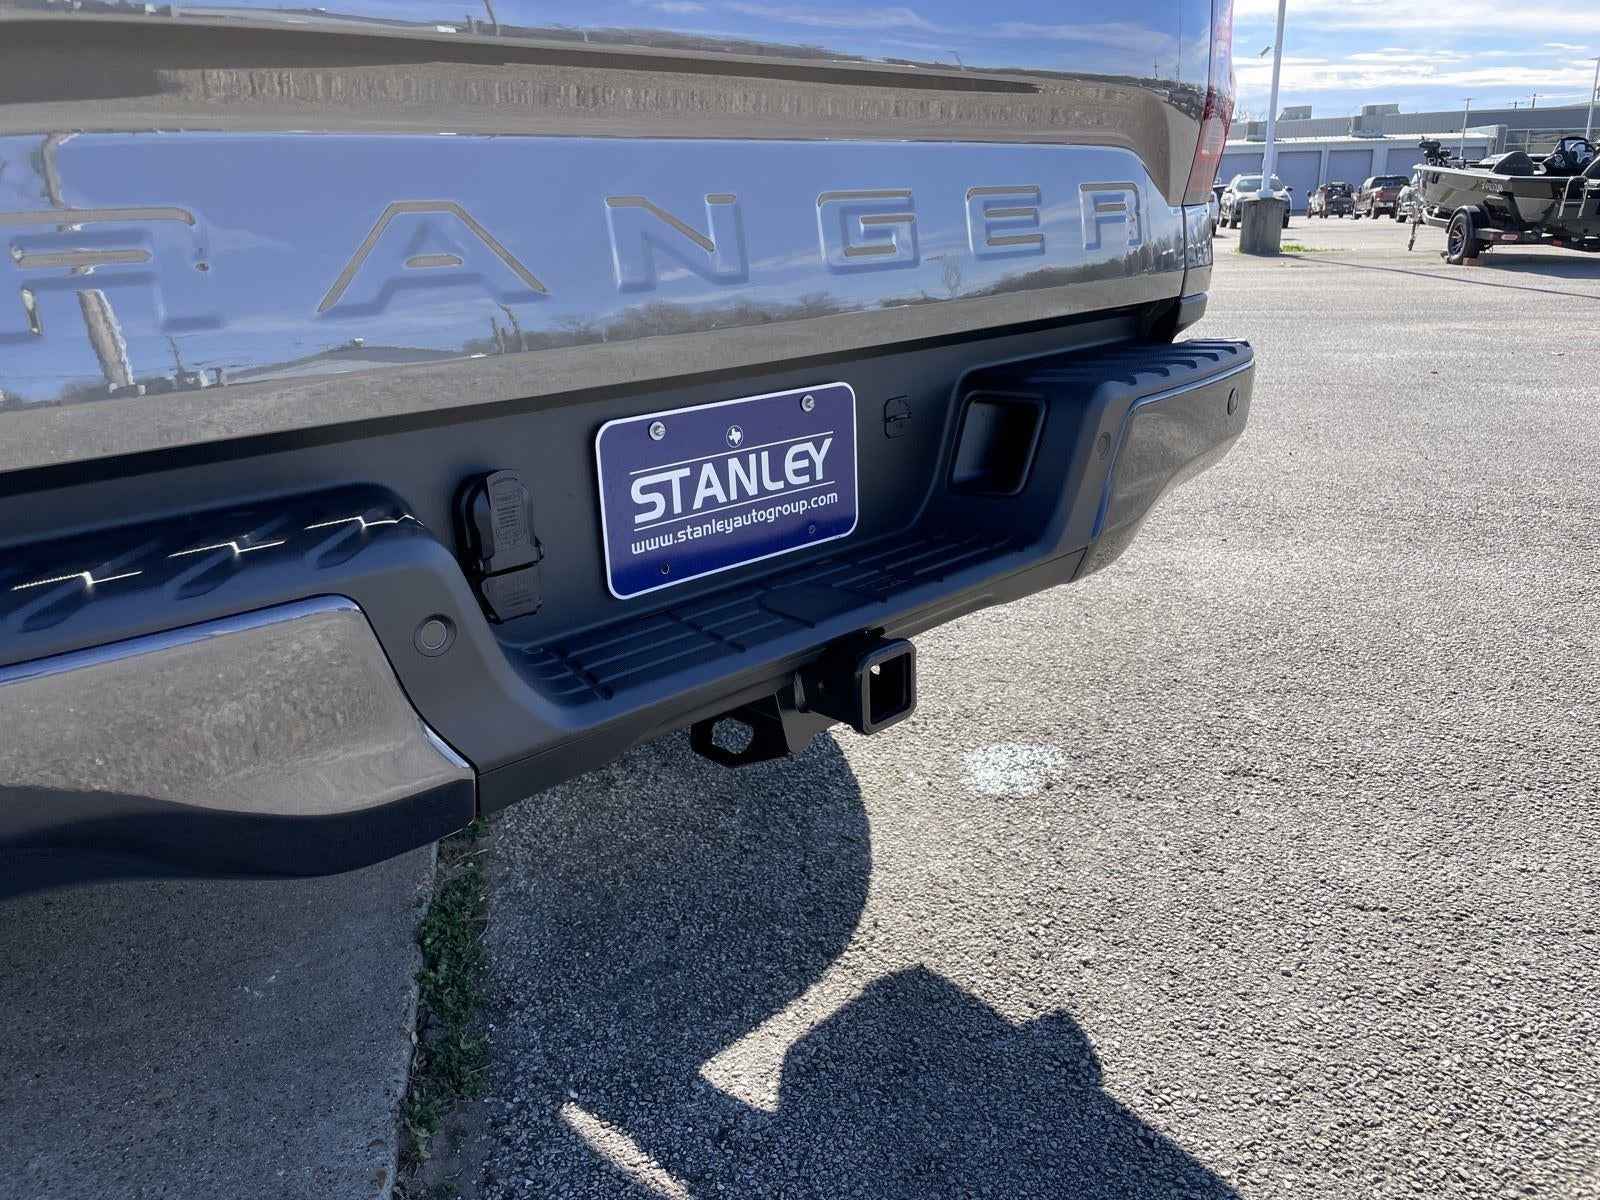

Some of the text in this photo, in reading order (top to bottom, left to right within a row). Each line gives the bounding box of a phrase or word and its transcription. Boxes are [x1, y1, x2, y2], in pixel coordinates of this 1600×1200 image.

[0, 182, 1142, 345] RANGER
[630, 437, 833, 524] STANLEY
[631, 492, 838, 555] www.stanleyautogroup.com
